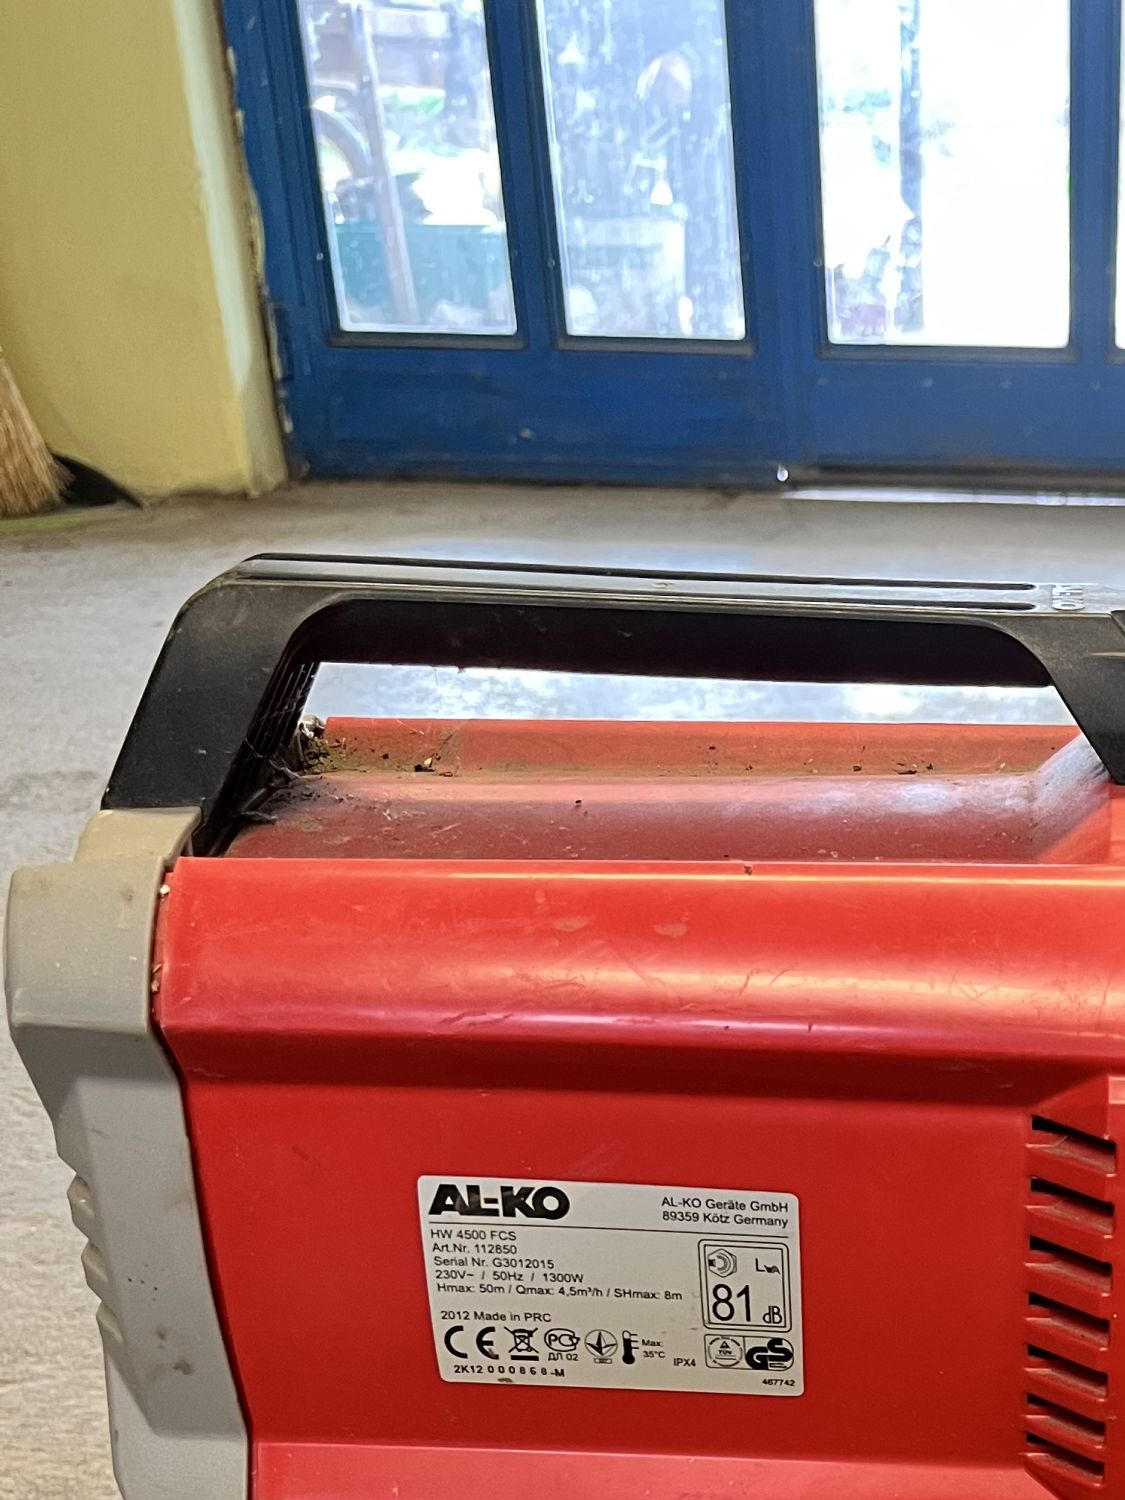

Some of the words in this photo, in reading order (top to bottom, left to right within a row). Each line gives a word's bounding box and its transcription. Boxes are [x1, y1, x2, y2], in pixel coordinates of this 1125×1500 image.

[428, 1184, 570, 1220] AL-KO
[661, 1197, 702, 1208] AL-KO
[705, 1199, 746, 1210] Geräte
[750, 1201, 789, 1212] GmbH
[662, 1211, 700, 1222] 89359
[703, 1213, 730, 1224] Kötz
[733, 1214, 789, 1229] Germany
[430, 1229, 453, 1239] HW
[456, 1230, 487, 1240] 4500
[490, 1231, 517, 1241] FCS
[474, 1244, 518, 1255] 112850
[433, 1256, 468, 1267] Serial
[471, 1257, 489, 1267] Nr.
[492, 1257, 555, 1269] G3012015
[435, 1269, 474, 1280] 230V~
[492, 1271, 525, 1282] 50Hz
[543, 1273, 584, 1283] 1300W
[437, 1283, 475, 1293] Hmax:
[479, 1283, 505, 1293] 50m
[515, 1285, 555, 1295] Qmax:
[614, 1288, 660, 1299] SHmax:
[664, 1290, 683, 1300] 8m
[712, 1283, 751, 1322] 81
[762, 1305, 783, 1324] dB
[440, 1310, 470, 1320] 2012
[474, 1311, 506, 1321] Made
[510, 1311, 520, 1321] in
[524, 1312, 552, 1323] PRC
[444, 1325, 499, 1360] CE
[566, 1353, 579, 1361] 02
[642, 1350, 666, 1359] 35°C
[673, 1357, 697, 1367] IPX4
